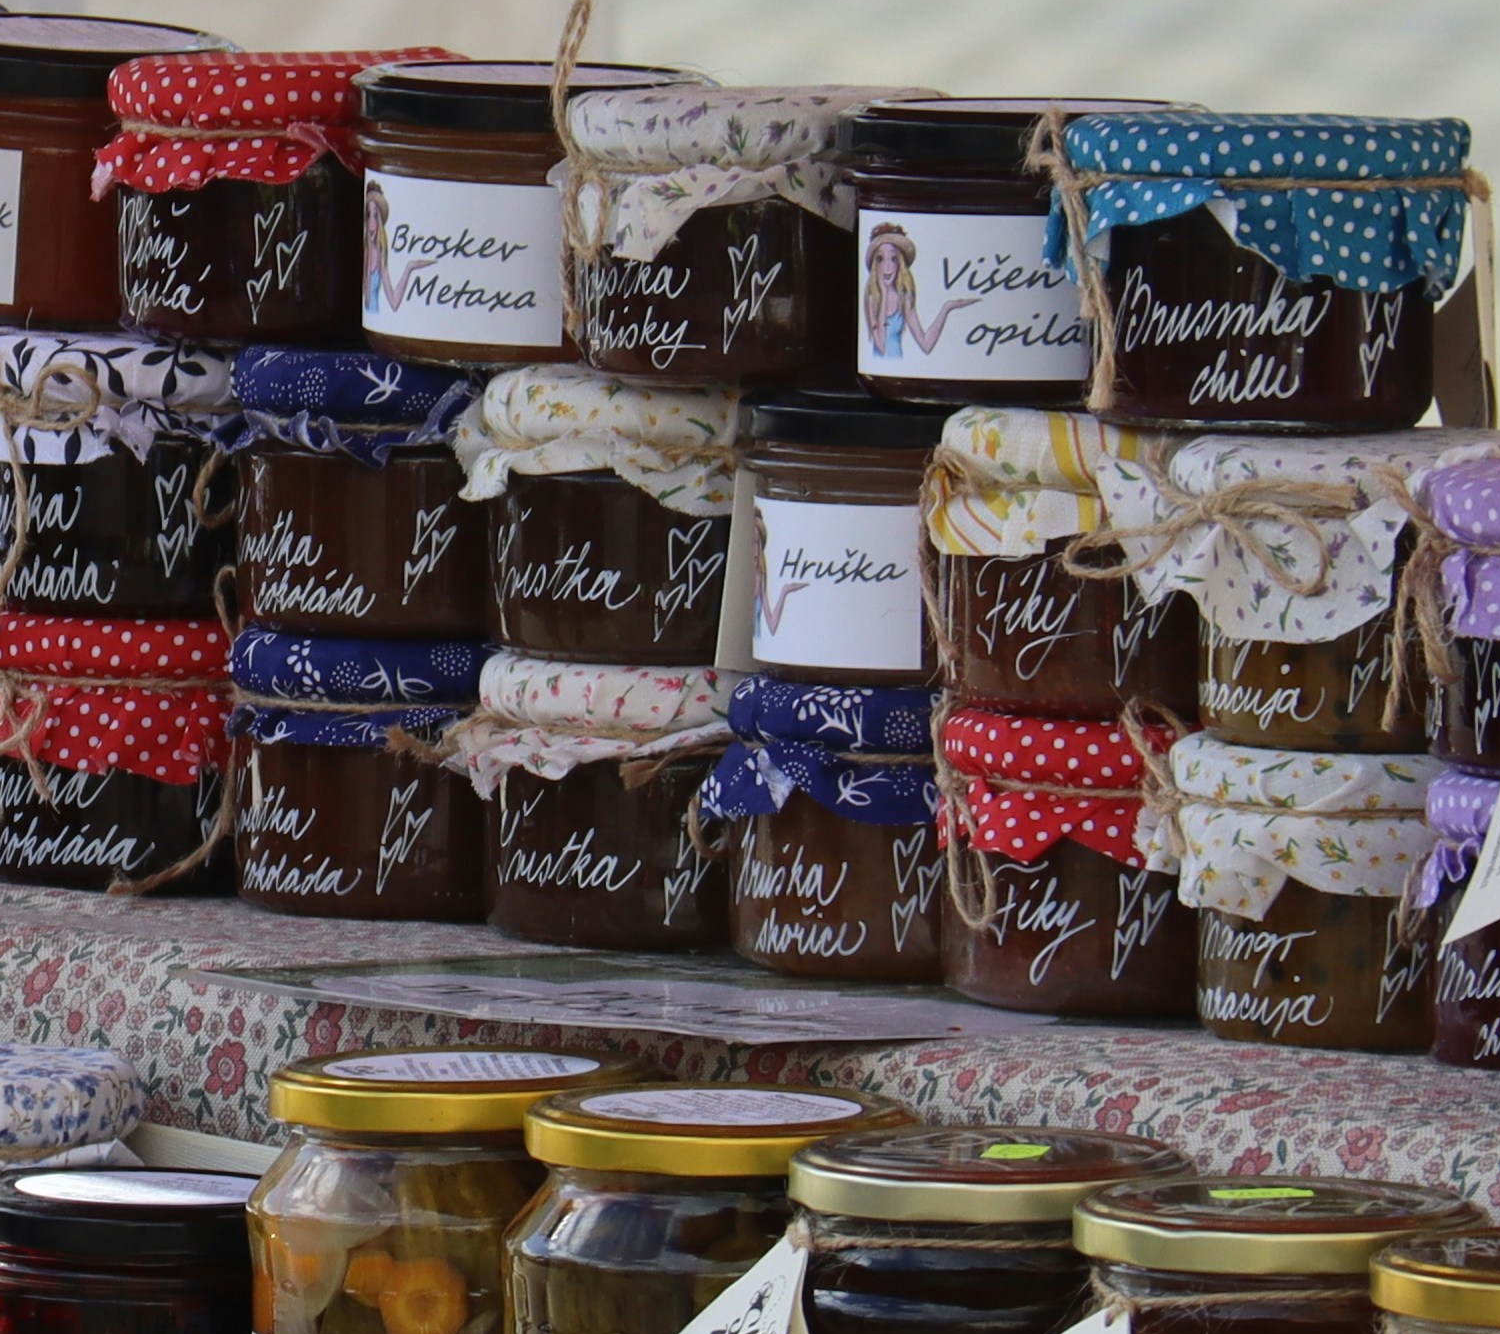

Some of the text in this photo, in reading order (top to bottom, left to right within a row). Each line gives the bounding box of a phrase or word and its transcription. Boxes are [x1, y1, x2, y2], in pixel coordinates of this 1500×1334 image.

[391, 224, 529, 262] Broskev
[405, 275, 537, 313] Metaxa
[965, 312, 1083, 357] opilá
[778, 547, 908, 583] Hruška
